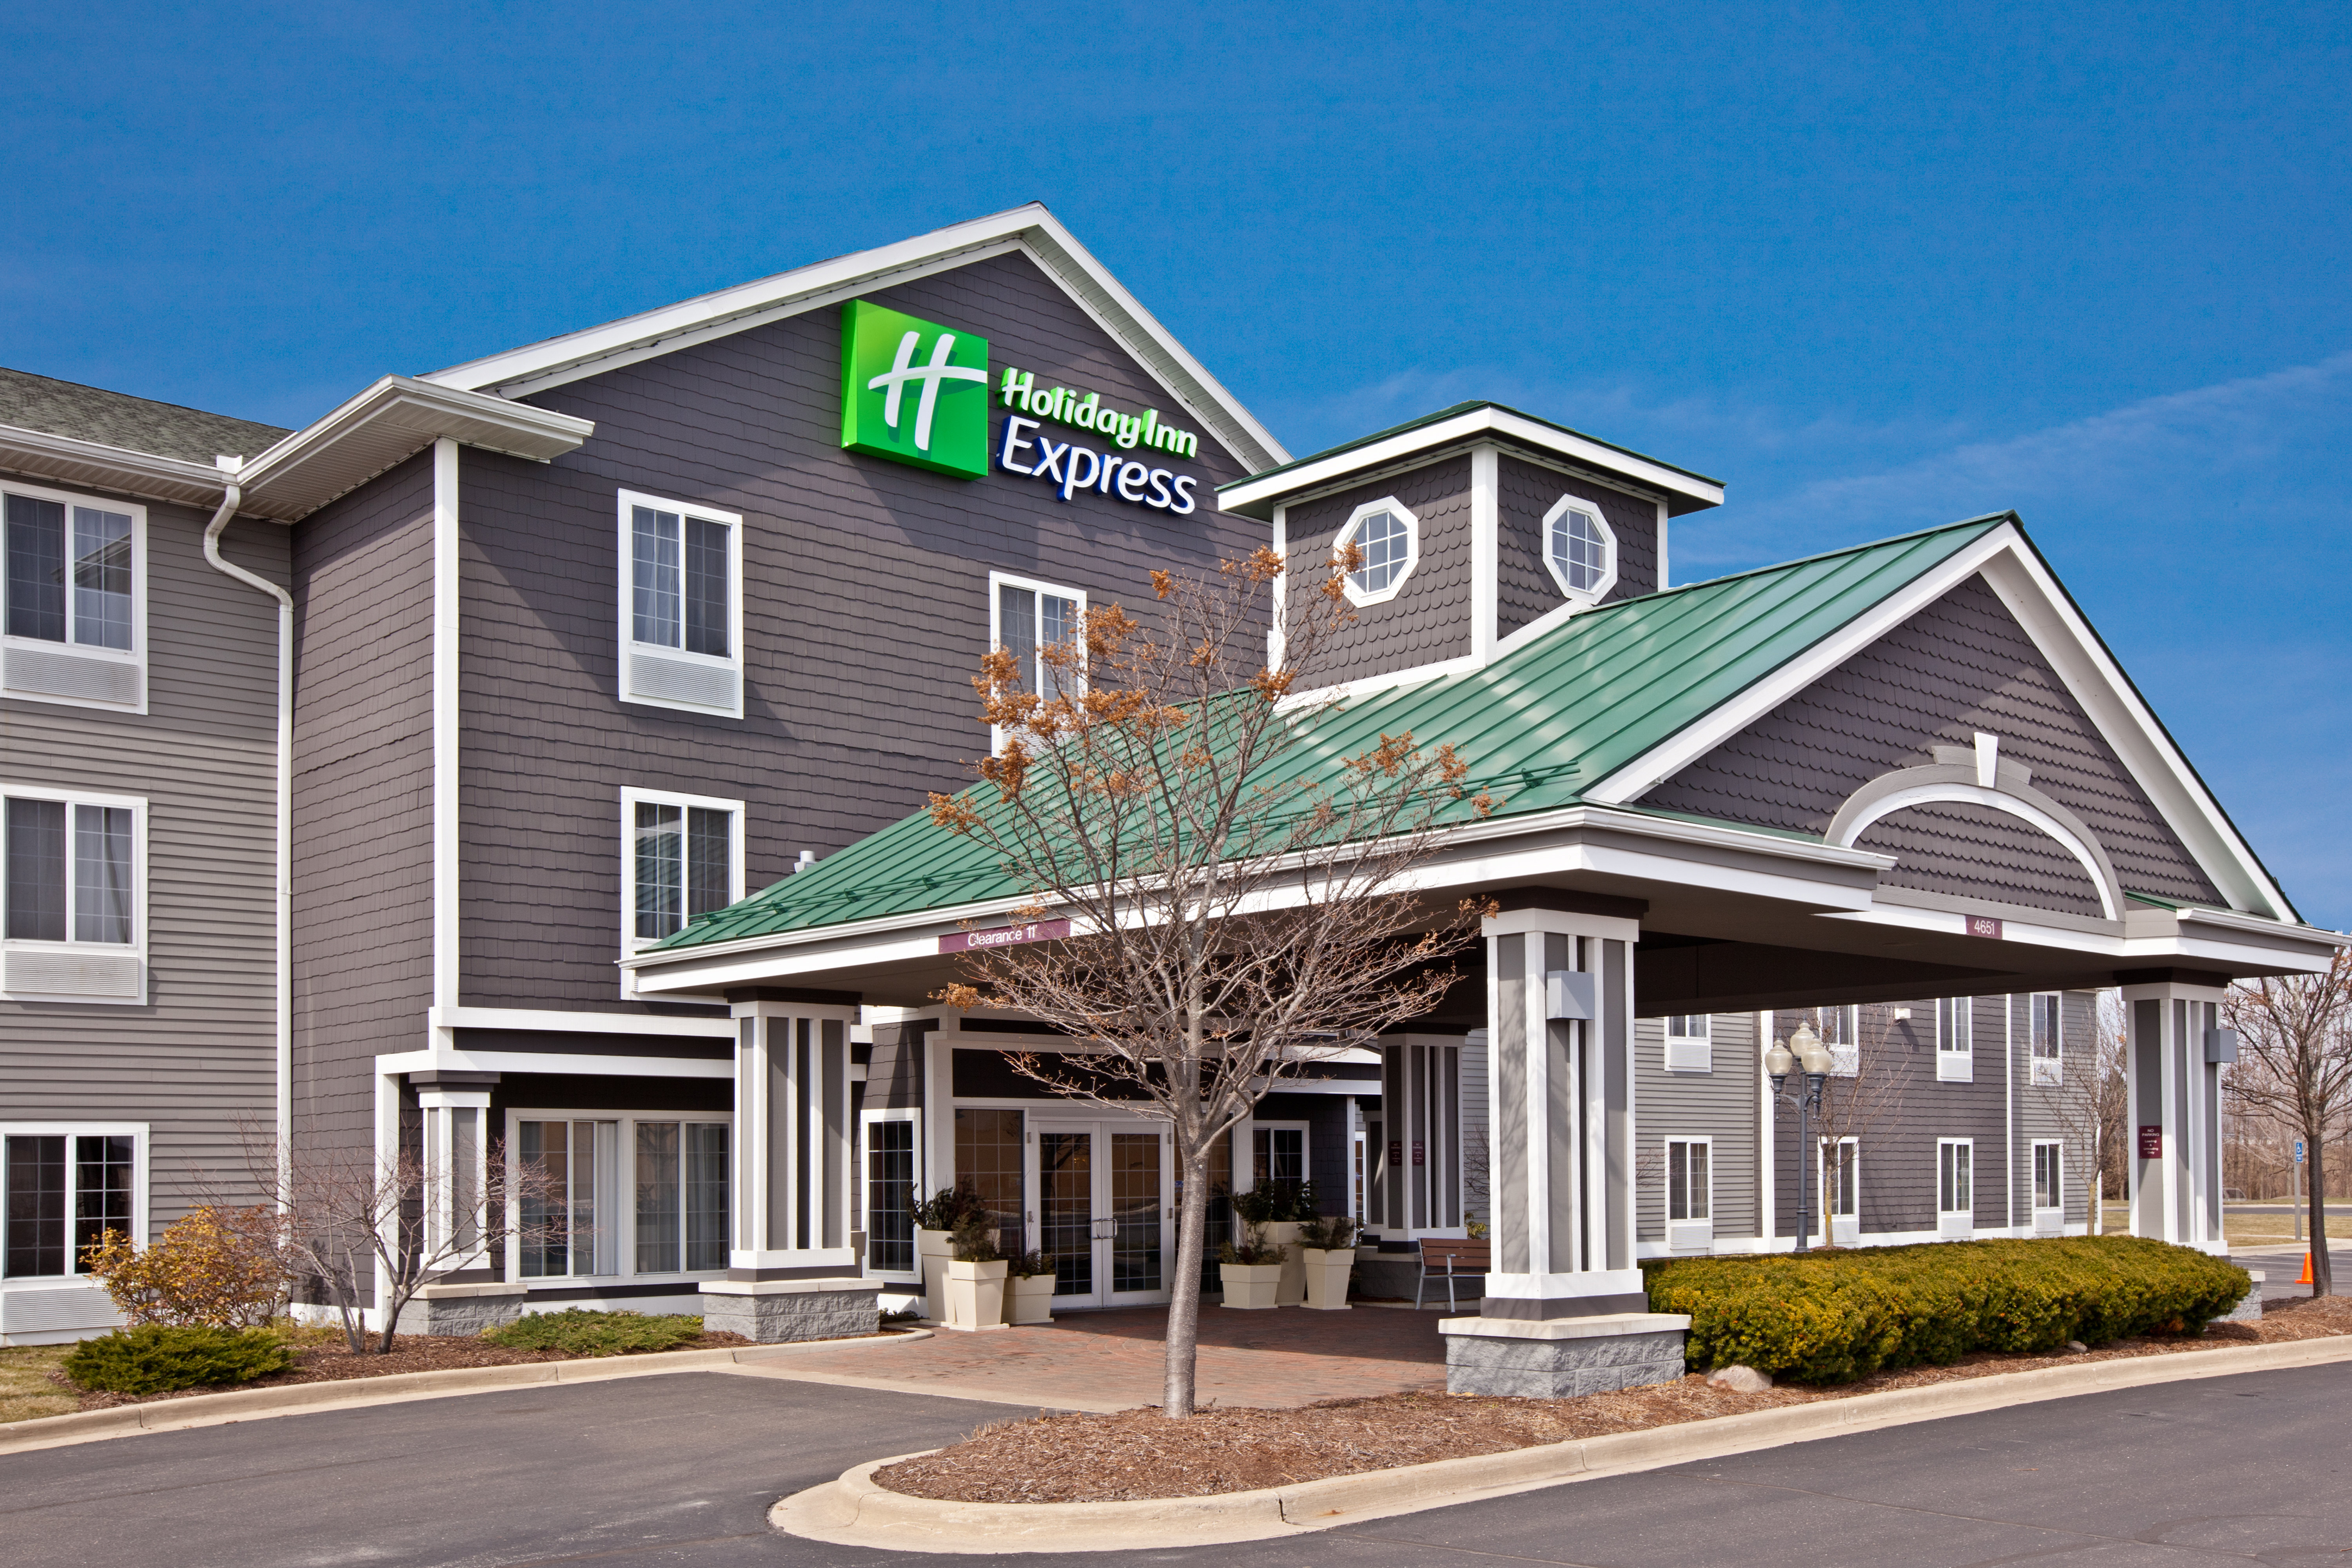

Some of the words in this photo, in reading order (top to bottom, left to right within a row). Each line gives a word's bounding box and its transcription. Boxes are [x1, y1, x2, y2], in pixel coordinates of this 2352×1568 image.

[998, 415, 1198, 515] Express
[1974, 919, 1994, 935] 4651
[967, 929, 1022, 947] Clearance
